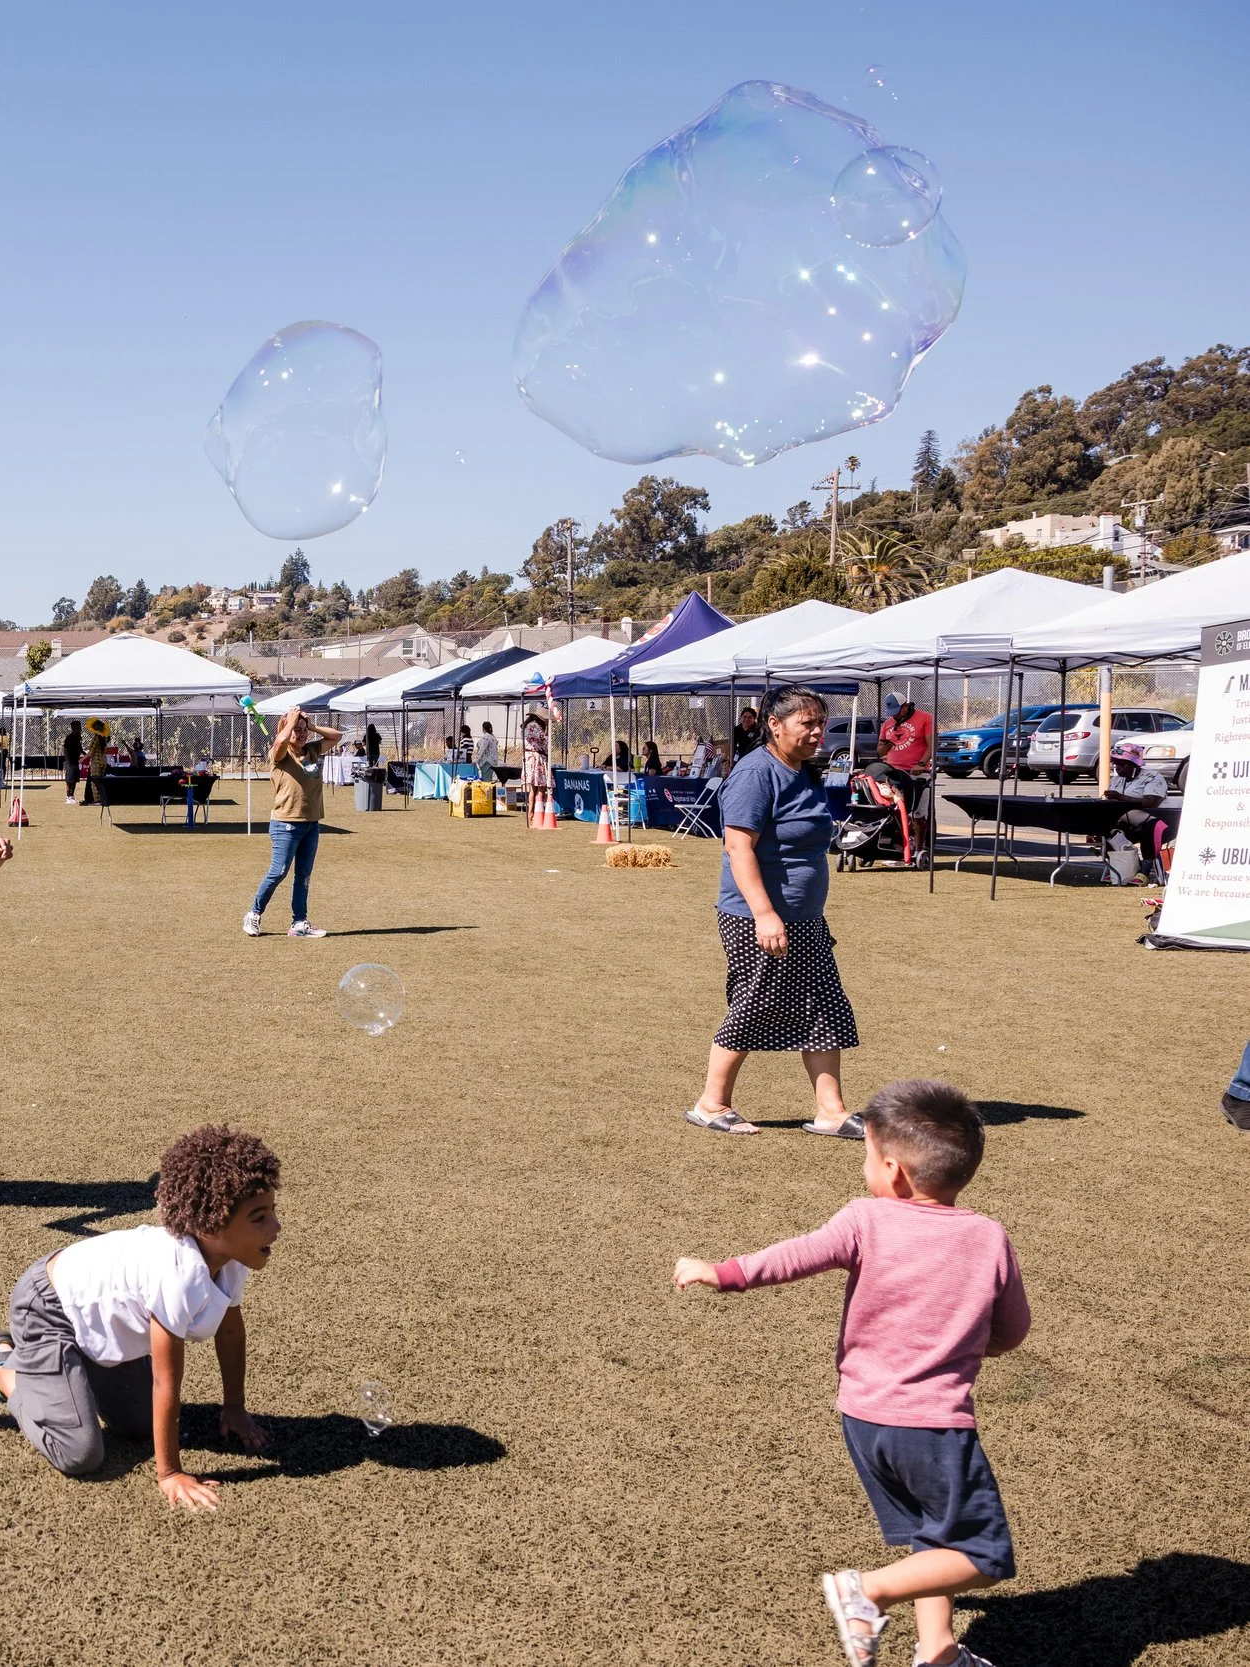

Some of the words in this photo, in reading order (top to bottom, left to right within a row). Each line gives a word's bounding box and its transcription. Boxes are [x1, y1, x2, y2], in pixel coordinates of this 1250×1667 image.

[1239, 674, 1250, 691] M
[563, 778, 590, 792] BANANAS
[1236, 801, 1246, 811] &
[1222, 848, 1250, 865] UBU
[1205, 870, 1243, 882] because
[1178, 886, 1193, 896] We
[1194, 888, 1211, 896] are
[1213, 887, 1250, 899] because
